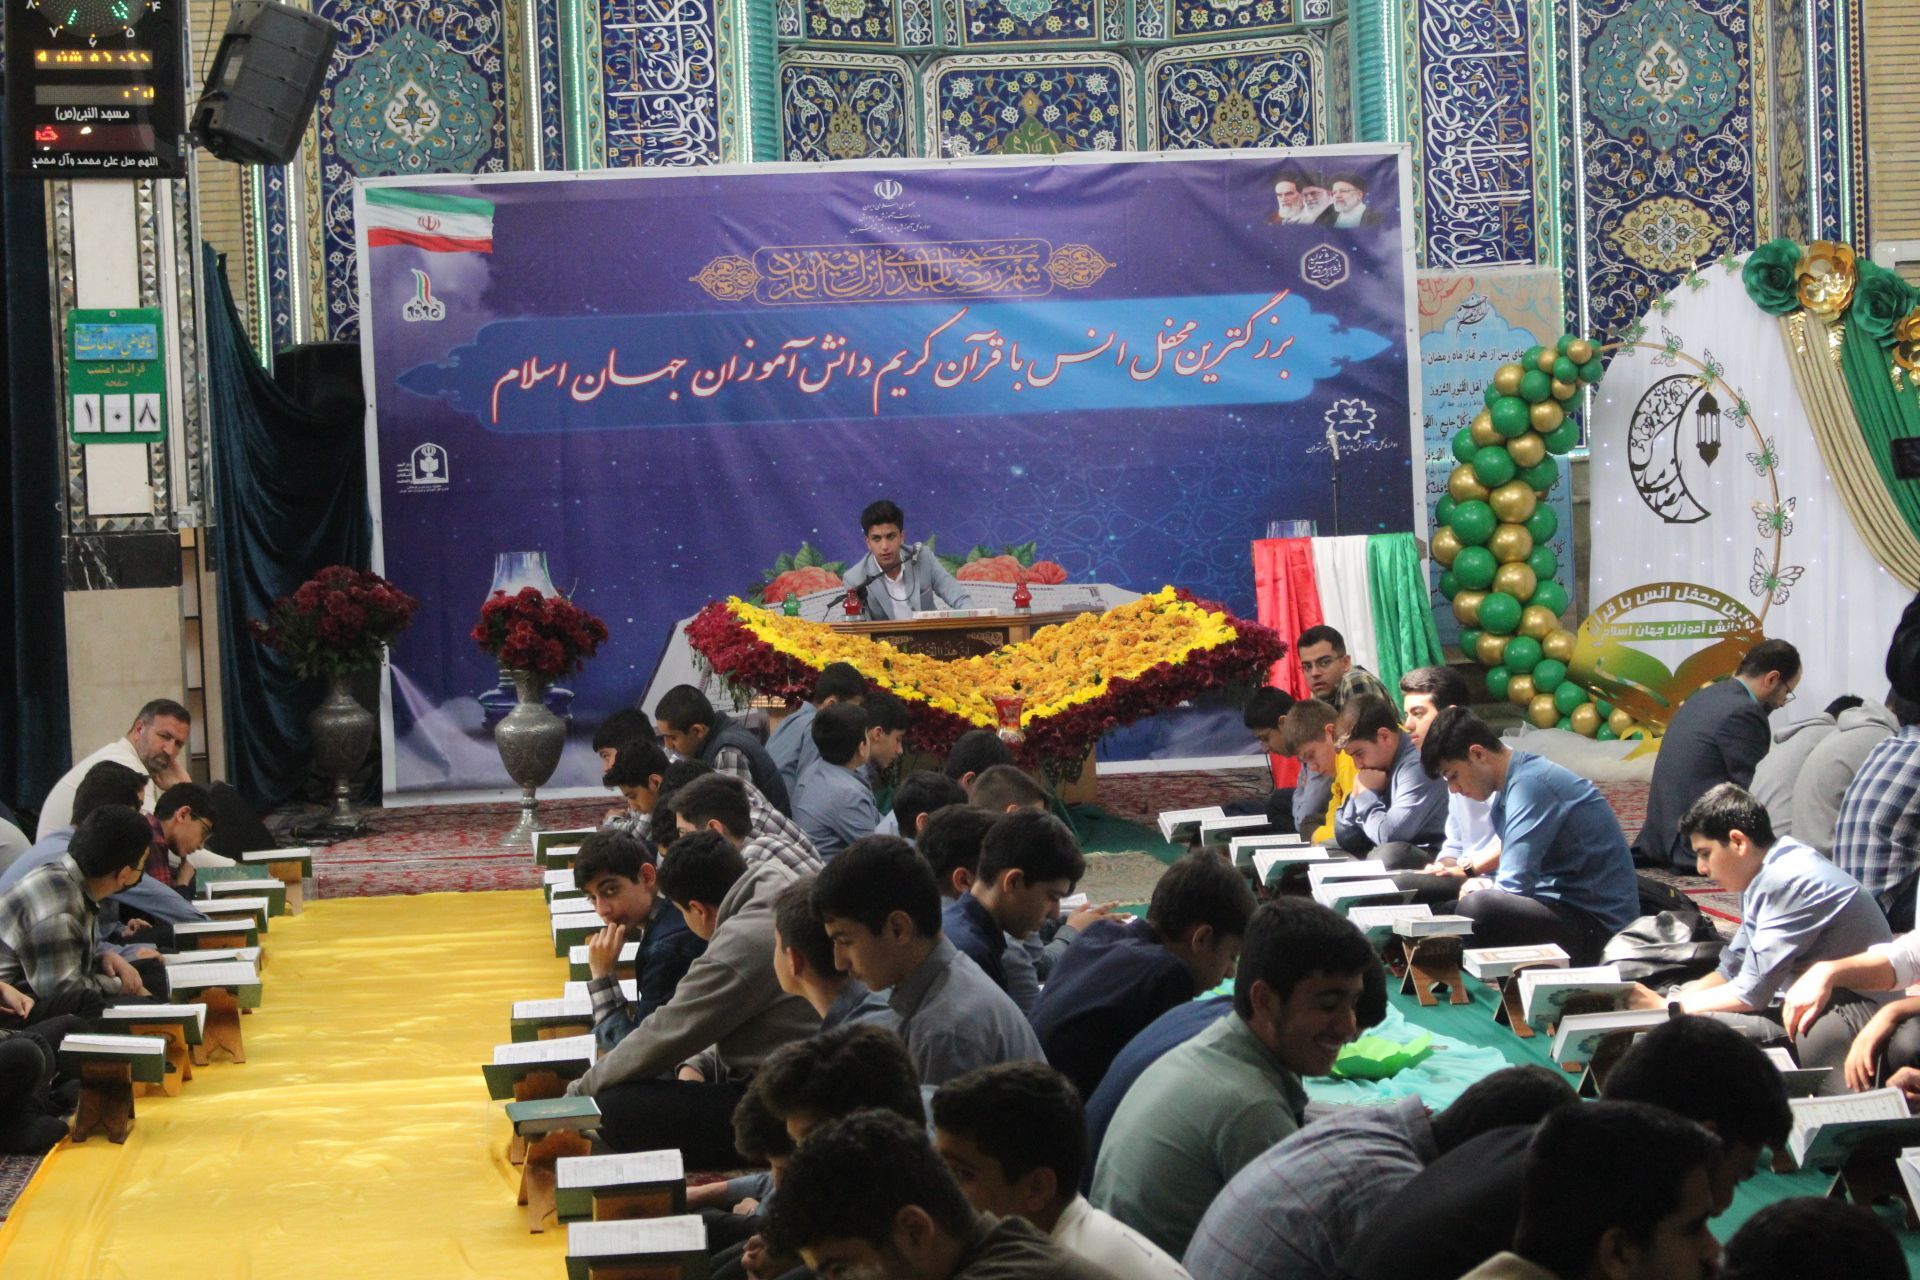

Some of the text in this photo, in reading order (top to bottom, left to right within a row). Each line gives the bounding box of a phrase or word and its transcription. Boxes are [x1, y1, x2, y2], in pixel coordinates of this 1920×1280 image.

[100, 109, 130, 121] مسجد
[76, 157, 101, 166] محمد
[103, 156, 119, 167] علی
[120, 156, 136, 168] صل
[138, 156, 158, 168] اللهم
[491, 289, 1294, 425] بزرگترین محفل انس با قرآن کریم دانش آموزان جهان اسلام
[1618, 594, 1632, 610] با
[1636, 585, 1671, 607] انس
[1675, 586, 1720, 607] محفل
[1635, 624, 1665, 637] جهان
